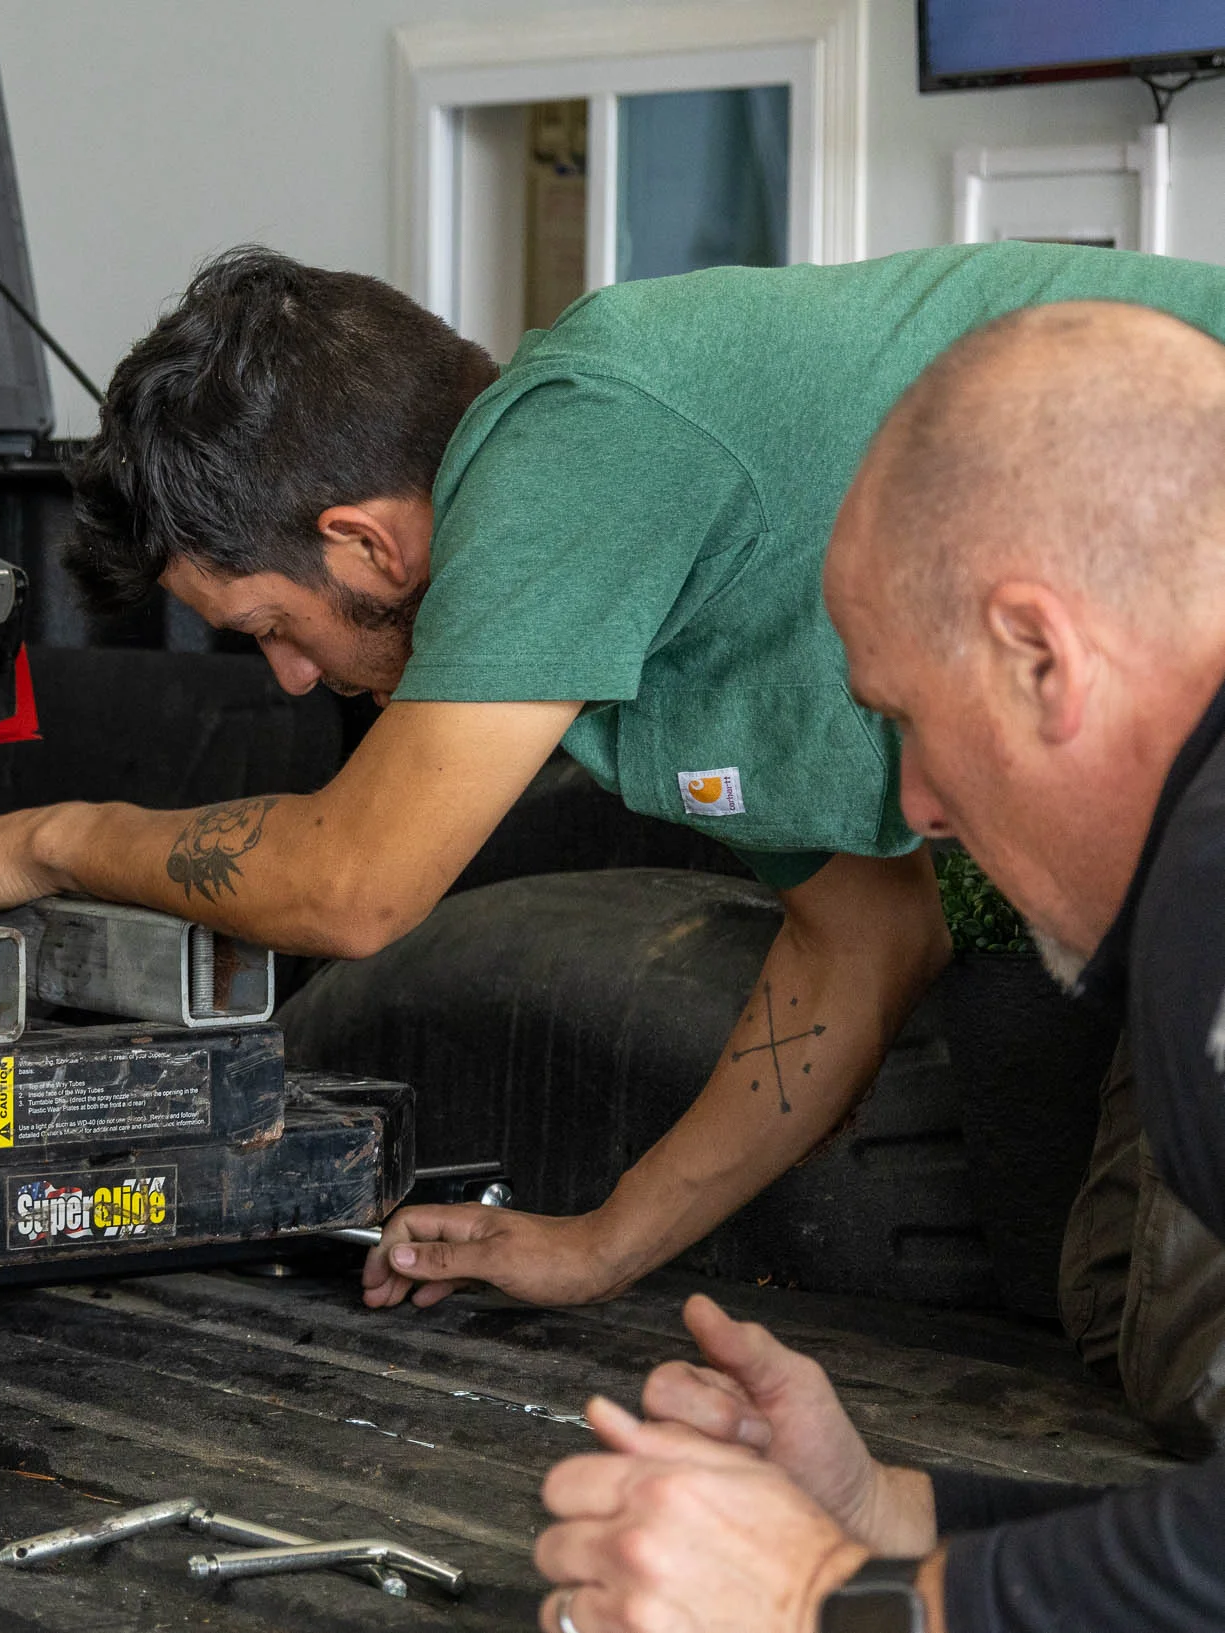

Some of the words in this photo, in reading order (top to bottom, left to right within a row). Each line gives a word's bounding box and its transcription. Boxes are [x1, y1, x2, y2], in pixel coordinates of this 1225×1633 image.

[724, 776, 736, 810] carhartt
[0, 1061, 8, 1119] CAUTION
[74, 1087, 87, 1095] Way
[28, 1098, 53, 1106] Turntable
[69, 1095, 87, 1103] (direct
[87, 1094, 96, 1102] the
[96, 1094, 112, 1103] spray
[162, 1089, 184, 1098] opening
[28, 1106, 46, 1114] Plastic
[35, 1123, 48, 1131] light
[18, 1131, 40, 1139] detailed
